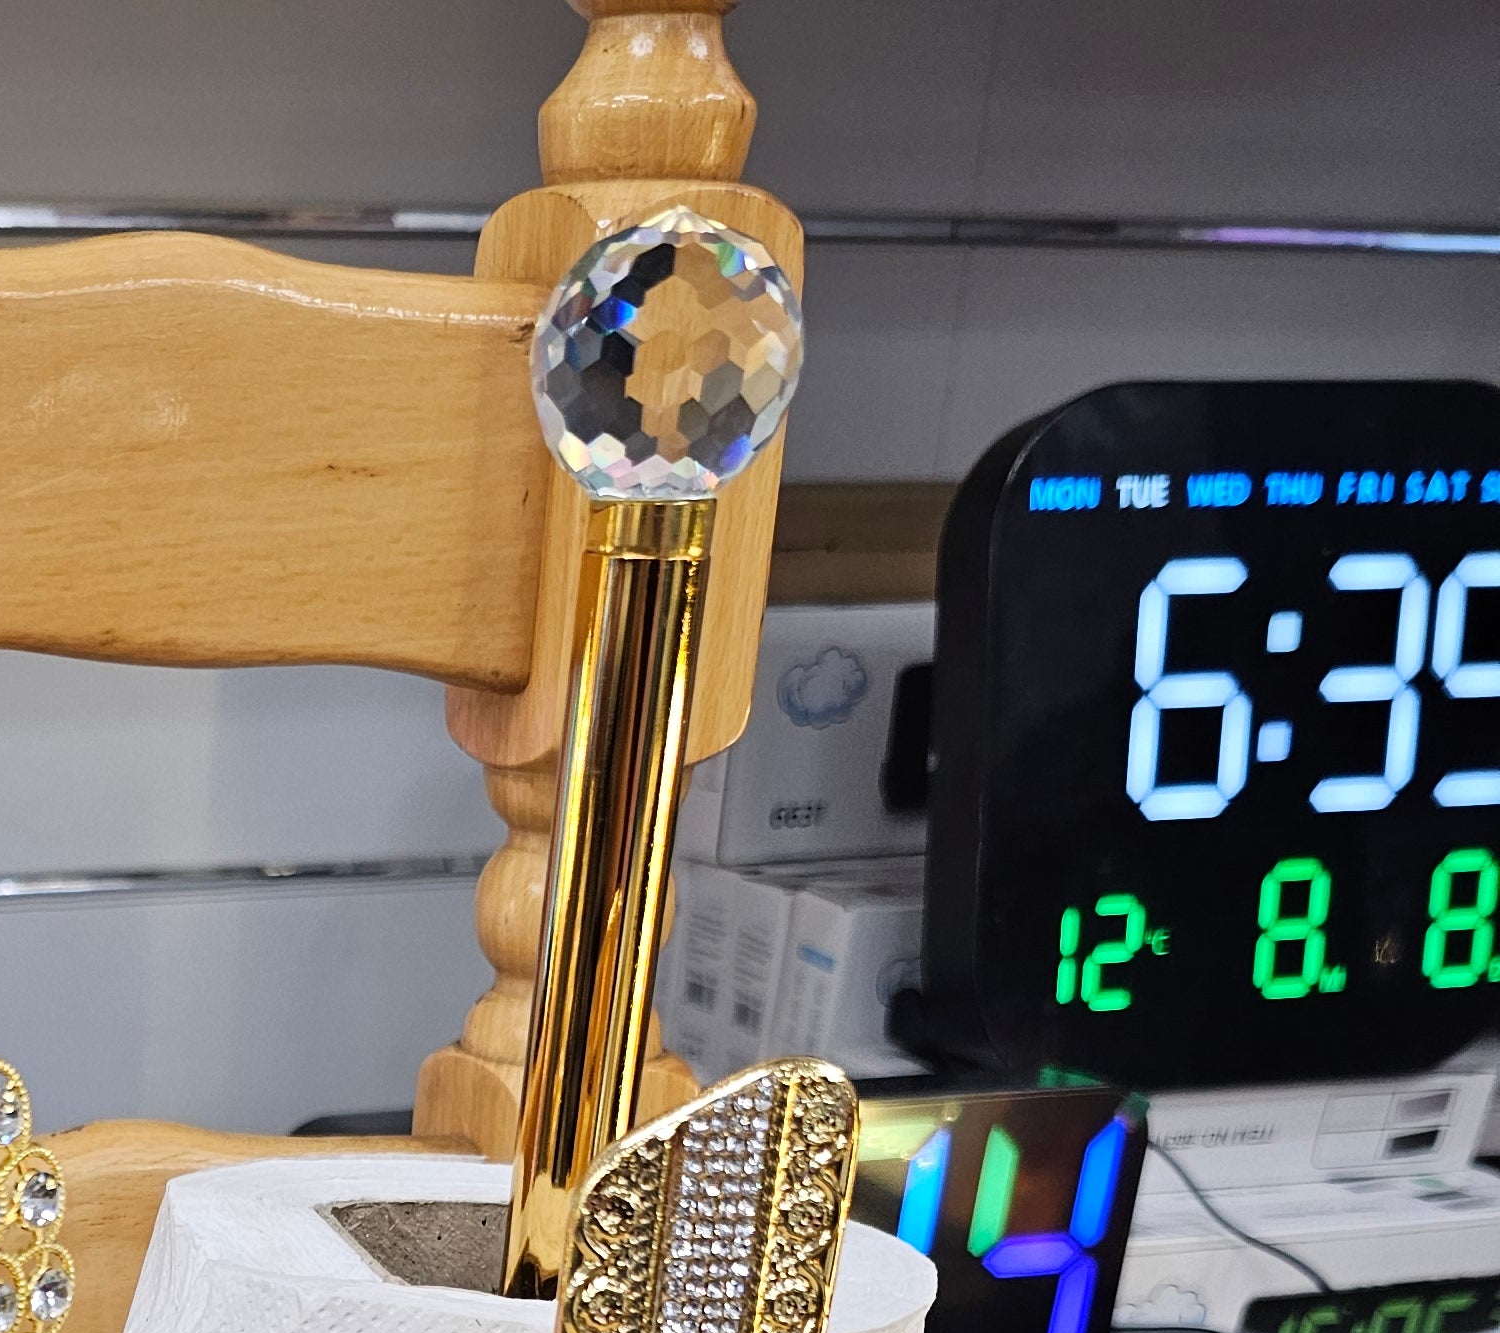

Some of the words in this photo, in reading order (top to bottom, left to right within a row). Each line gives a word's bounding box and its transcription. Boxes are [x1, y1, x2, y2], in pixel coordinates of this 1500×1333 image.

[1029, 476, 1102, 511] MON
[1116, 474, 1171, 509] TUE
[1186, 472, 1251, 508] WED
[1264, 471, 1324, 506] THU
[1336, 471, 1395, 505] FRI
[1403, 470, 1471, 504] SAT
